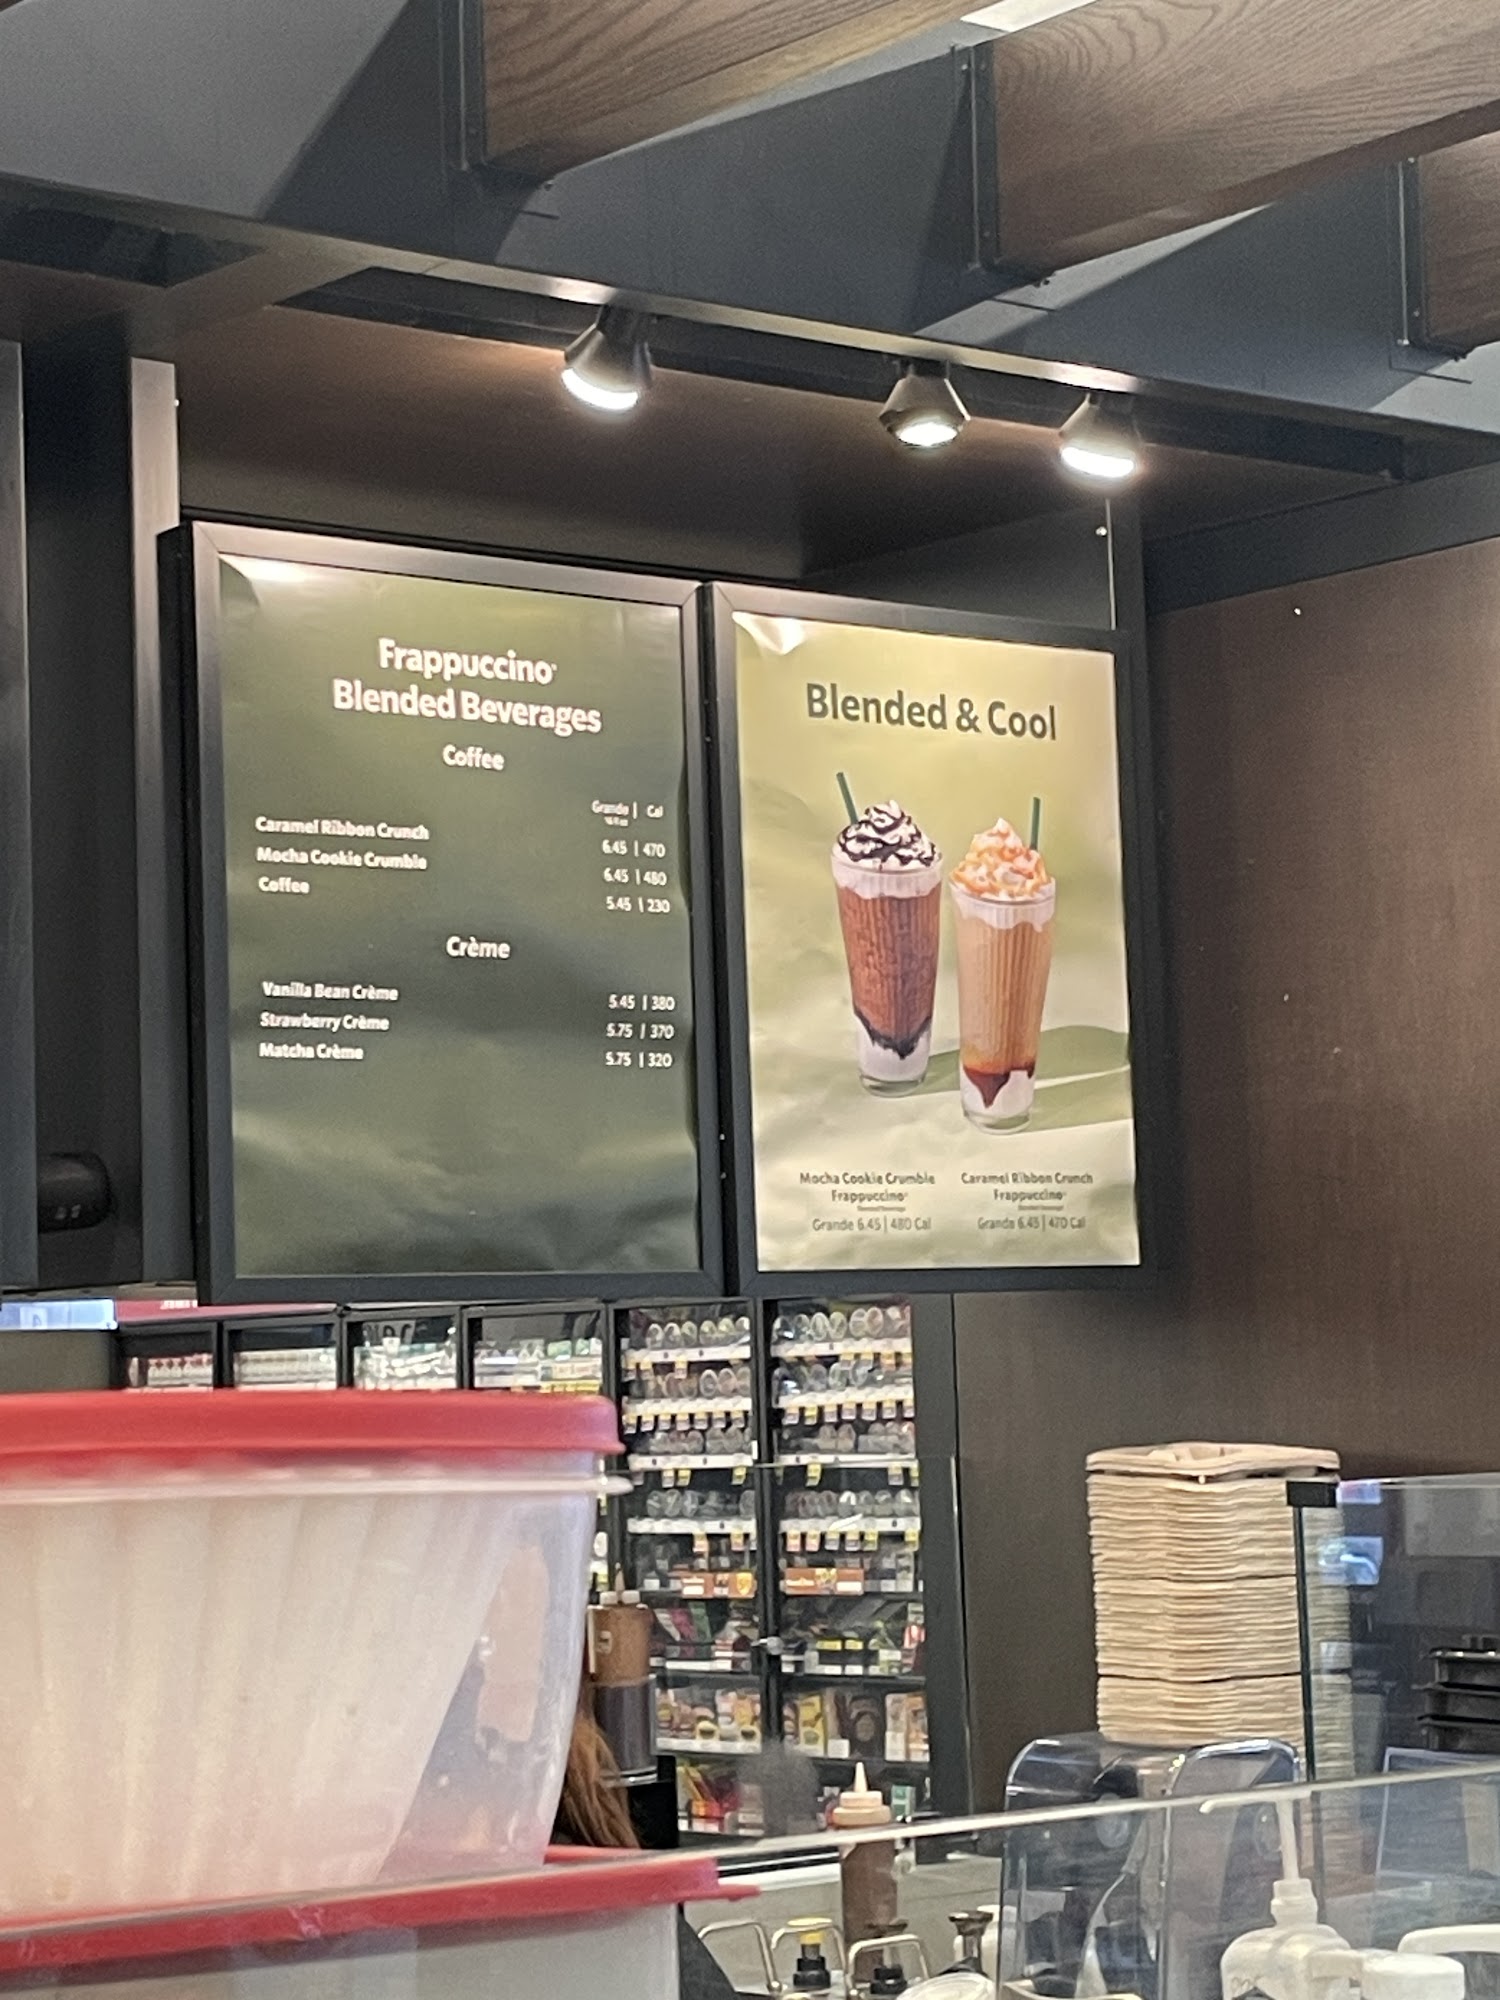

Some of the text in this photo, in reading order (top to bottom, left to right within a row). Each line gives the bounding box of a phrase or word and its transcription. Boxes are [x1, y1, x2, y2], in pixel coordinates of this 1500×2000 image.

[378, 637, 557, 685] Frappuccino
[332, 678, 602, 737] Blended Beverages
[806, 683, 1056, 741] Blended & Cool
[442, 744, 505, 771] Coffee
[255, 815, 430, 841] Caramel Ribbon Crunch
[602, 839, 628, 855] 6.45
[643, 842, 666, 858] 470
[256, 846, 428, 871] Mocha Cookie Crumble
[258, 876, 310, 894] Coffee
[603, 867, 630, 883] 6.45
[643, 871, 668, 886] 480
[606, 895, 632, 912] 5.45
[647, 898, 671, 914] 230
[446, 936, 511, 960] Crème
[262, 980, 399, 1001] Vanilla Bean Crème
[608, 993, 636, 1011] 5.45
[651, 995, 676, 1011] 380
[260, 1011, 390, 1033] Strawberry Crème
[606, 1022, 633, 1039] 5.75
[650, 1023, 675, 1040] 370
[259, 1042, 364, 1060] Matcha Crème
[605, 1051, 632, 1067] 5.75
[648, 1052, 673, 1068] 320
[799, 1172, 936, 1185] Mocha Cookie Crumble
[960, 1172, 1094, 1185] Caramel Ribbon Crunch
[831, 1189, 908, 1204] Frappuccino
[993, 1188, 1067, 1203] Frappuccino
[812, 1218, 855, 1232] Grande
[914, 1217, 932, 1231] Cal
